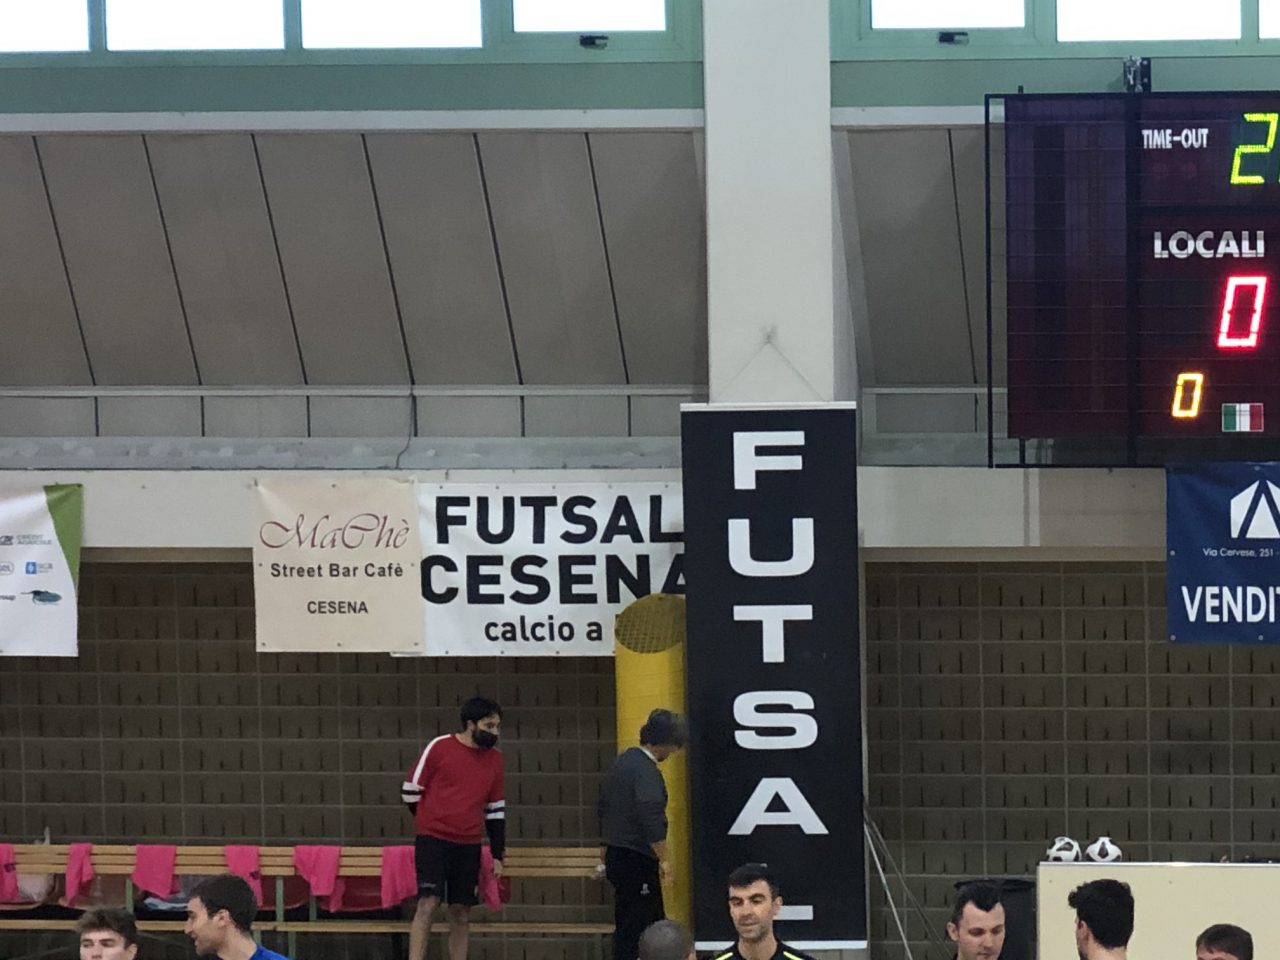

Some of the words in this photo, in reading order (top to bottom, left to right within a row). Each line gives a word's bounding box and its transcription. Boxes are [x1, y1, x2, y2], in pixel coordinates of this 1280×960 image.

[1142, 128, 1209, 149] TIME-OUT
[1154, 231, 1264, 258] LOCALI
[1217, 276, 1267, 347] 0
[1172, 373, 1203, 417] 0
[435, 495, 685, 544] FUTSAL
[1203, 548, 1218, 556] Via
[1260, 548, 1274, 556] 251
[270, 563, 323, 578] Street
[329, 564, 358, 577] Bar
[364, 563, 403, 577] Cafè
[307, 601, 368, 614] CESENA
[485, 615, 575, 641] calcio
[586, 621, 603, 641] a
